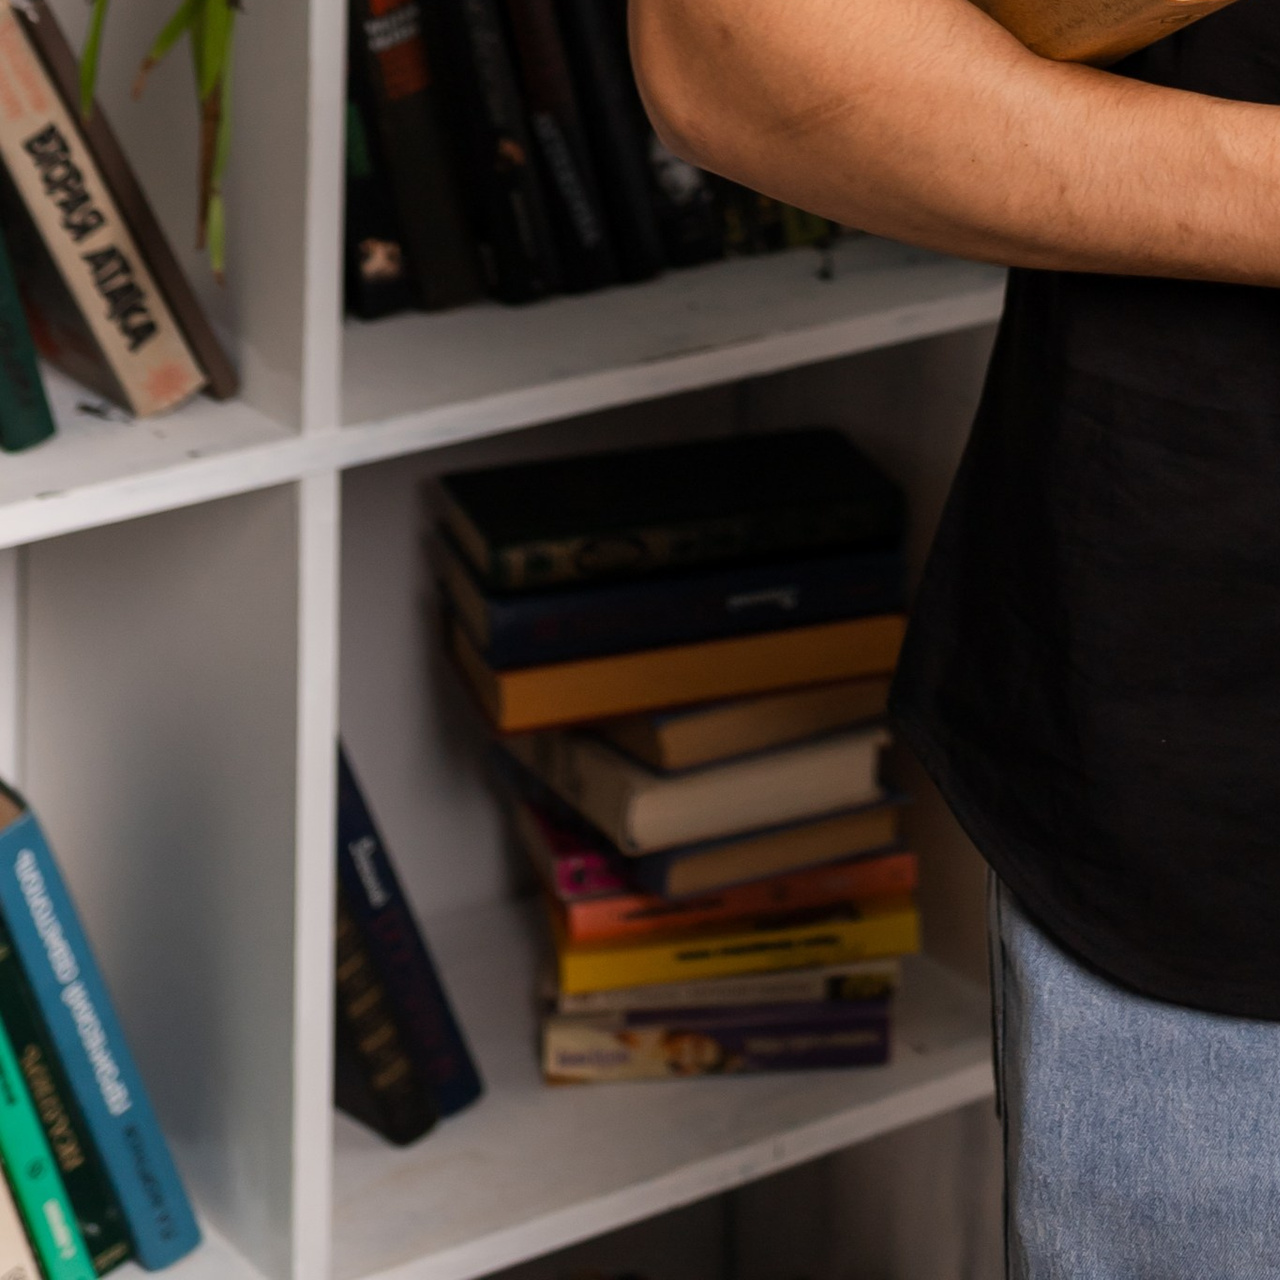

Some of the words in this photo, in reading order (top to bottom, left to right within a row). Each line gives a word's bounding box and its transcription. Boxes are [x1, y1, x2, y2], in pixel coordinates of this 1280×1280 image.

[23, 122, 106, 244] ВТОРАЯ
[82, 244, 158, 354] АТАКА
[14, 847, 79, 986] СЕВАСТОПОЛЬ
